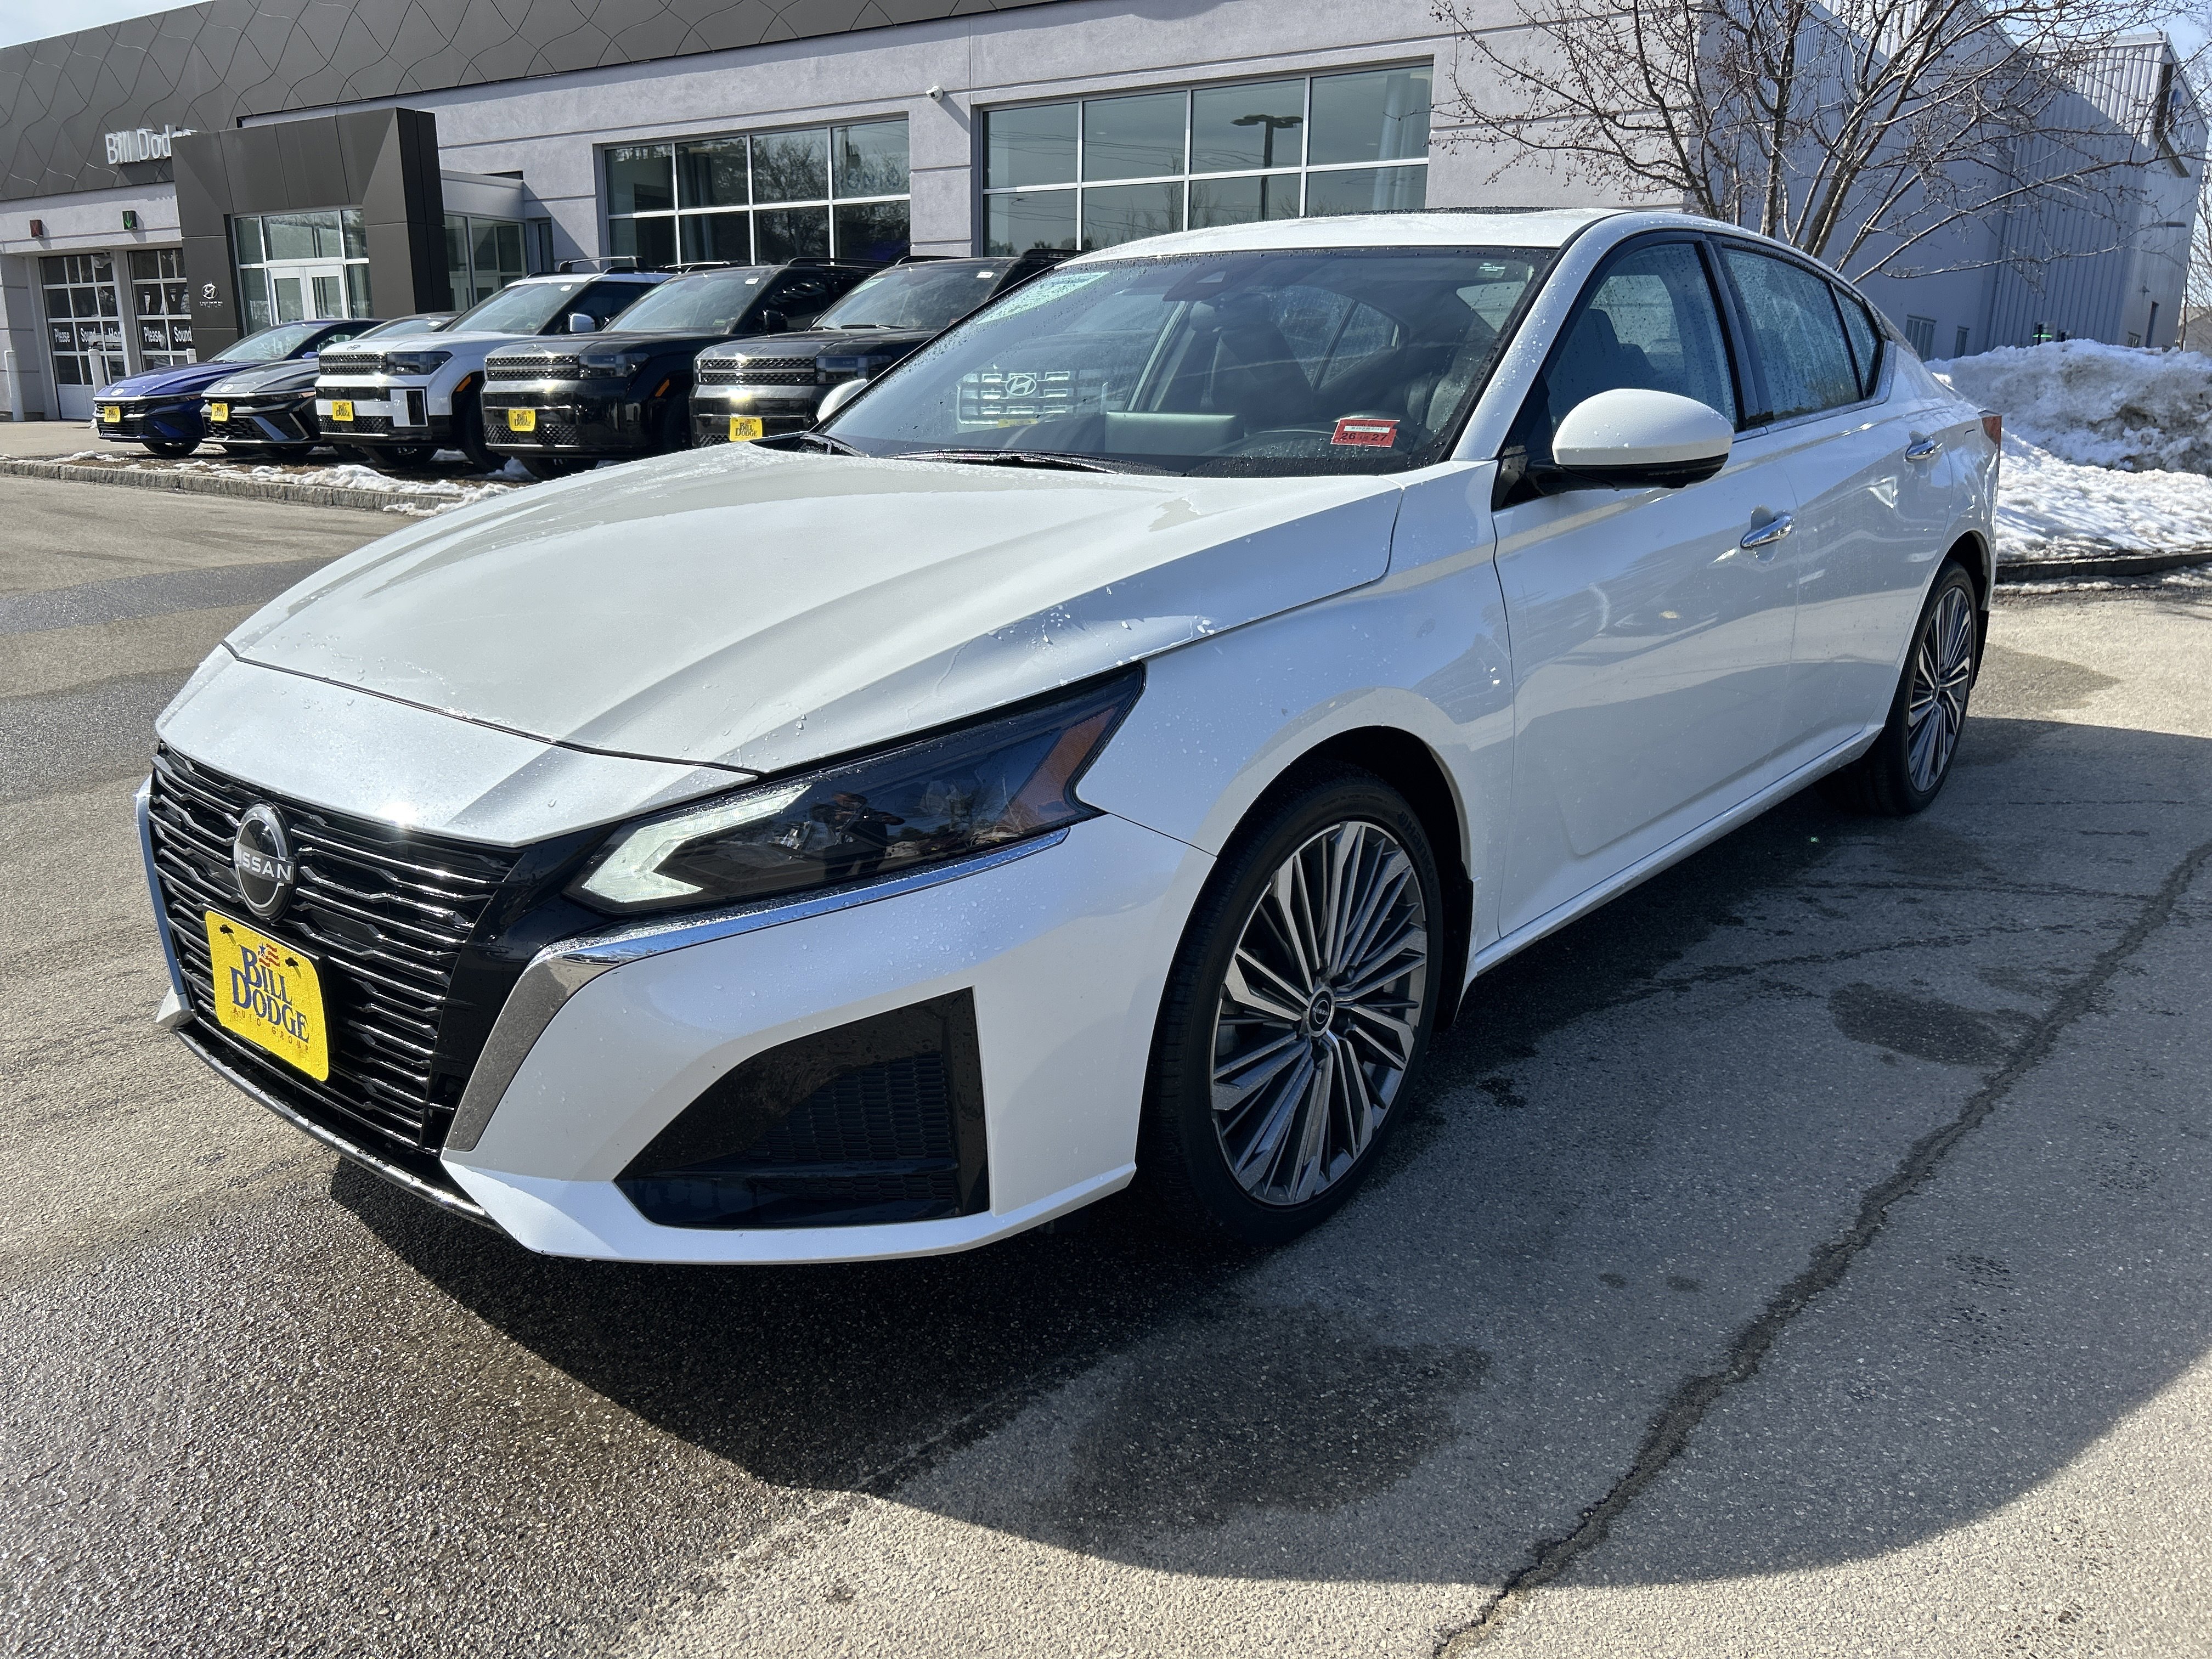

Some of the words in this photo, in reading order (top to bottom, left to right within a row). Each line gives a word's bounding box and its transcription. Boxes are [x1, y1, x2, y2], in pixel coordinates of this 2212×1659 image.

[105, 131, 133, 165] Bill
[136, 124, 198, 160] Dod
[144, 326, 162, 342] Please
[174, 326, 192, 342] Sound
[735, 428, 758, 437] DODGE
[740, 422, 754, 431] BILL
[239, 944, 292, 1006] BILL
[229, 966, 309, 1043] DODGE
[233, 1007, 261, 1026] AUTO
[272, 1026, 308, 1053] GROUP
